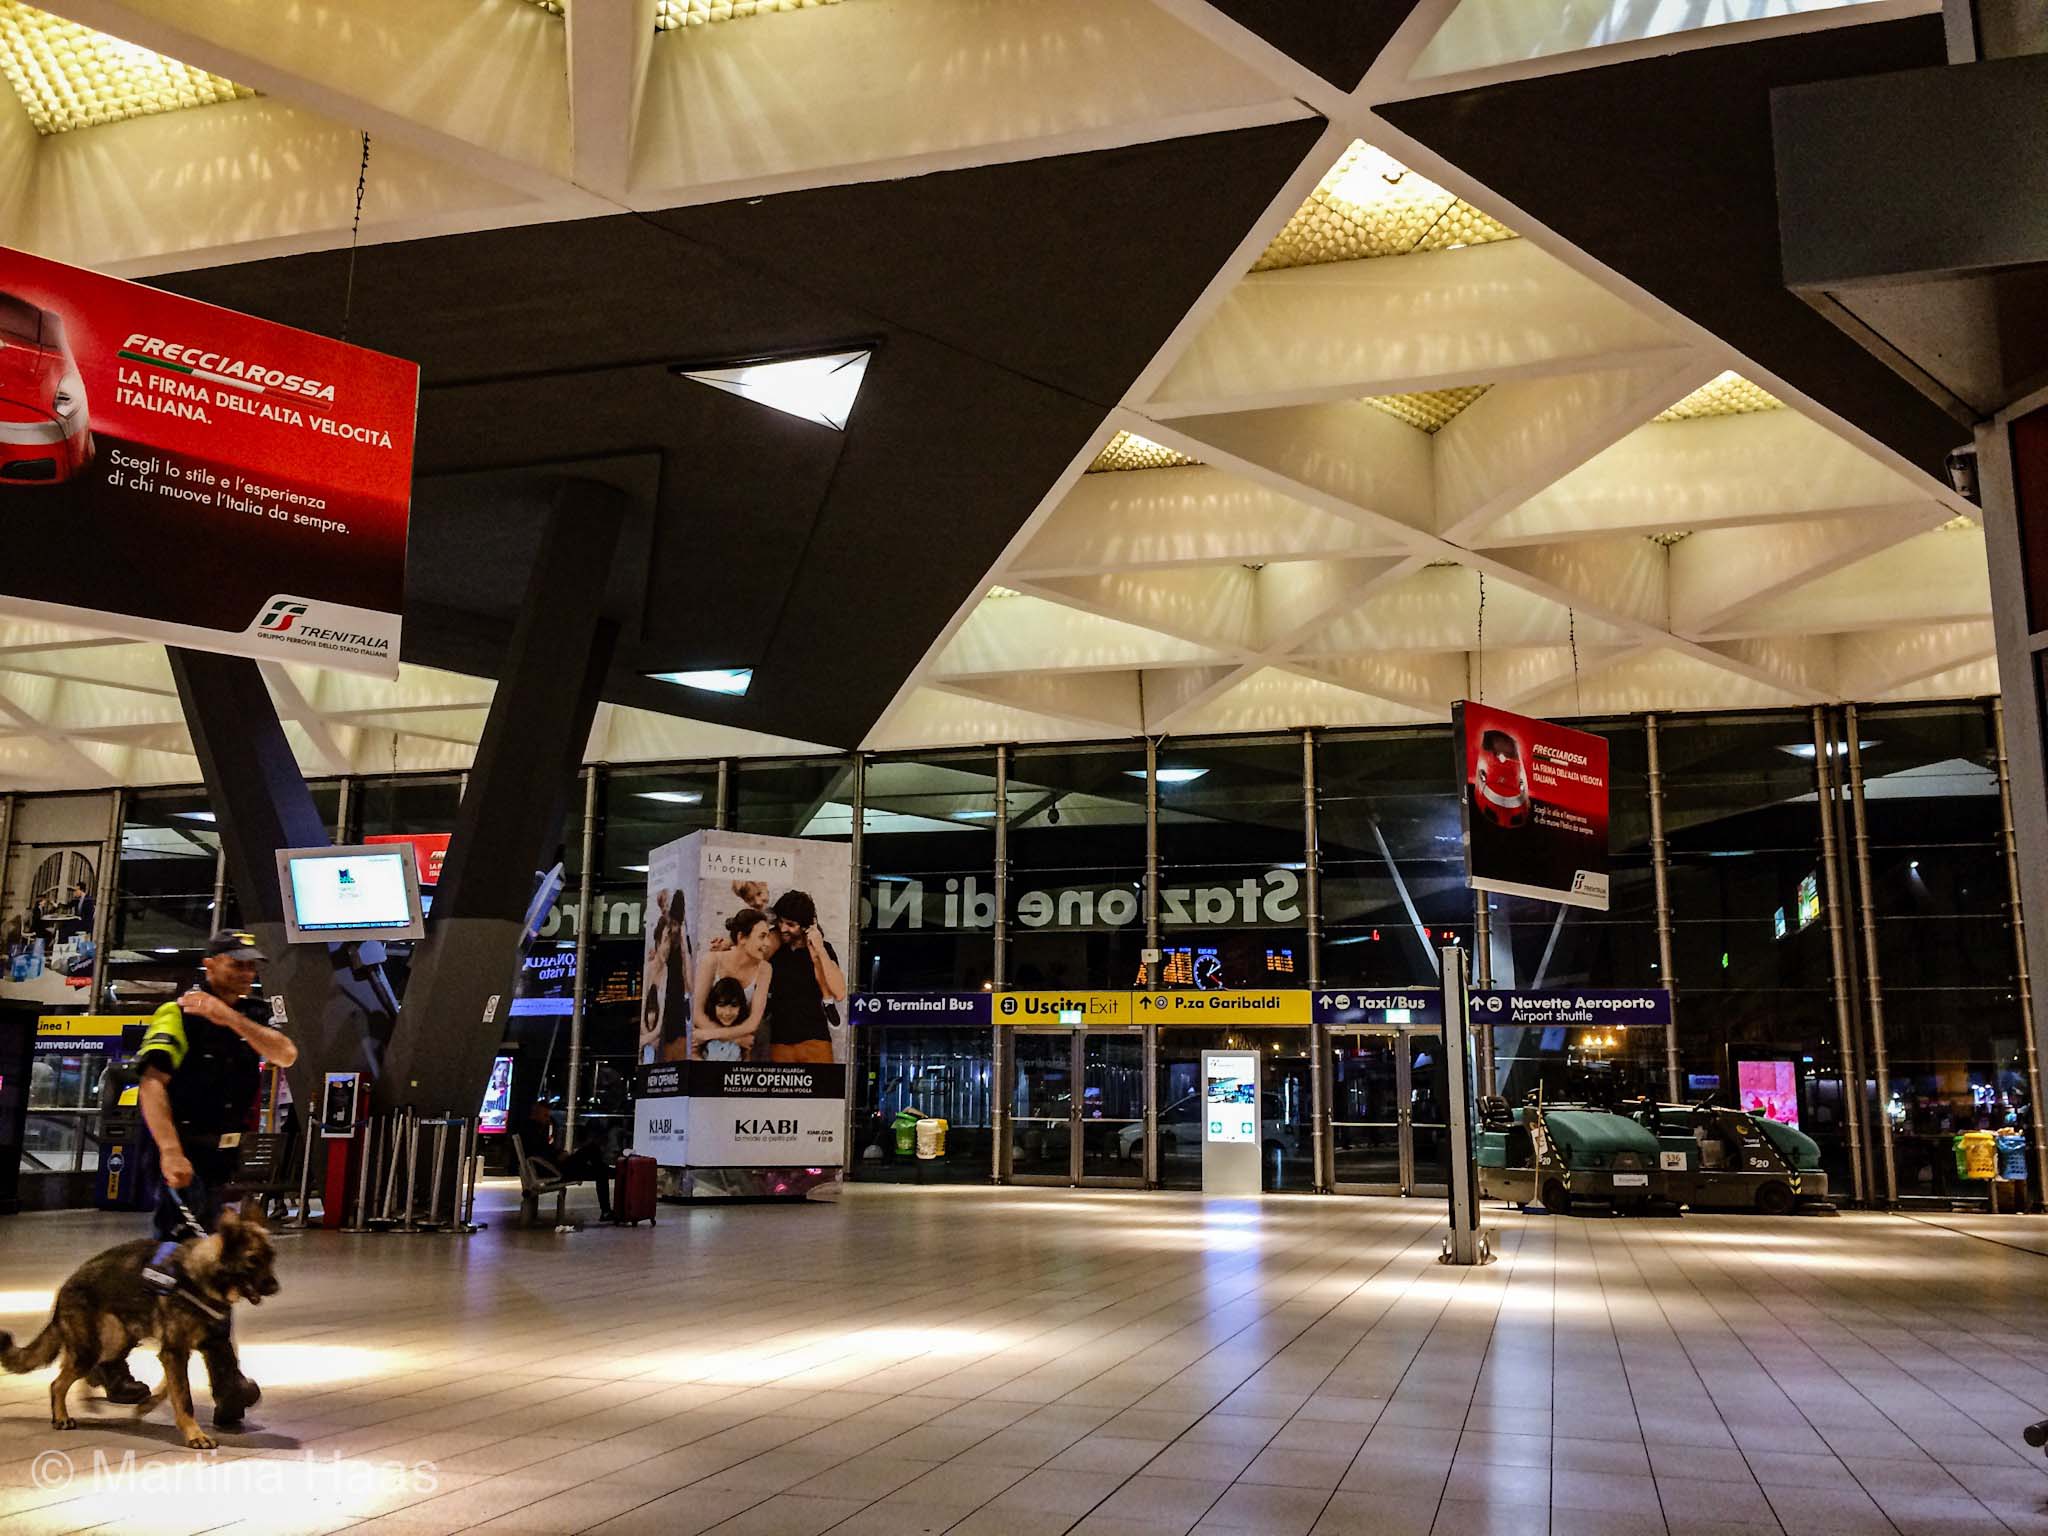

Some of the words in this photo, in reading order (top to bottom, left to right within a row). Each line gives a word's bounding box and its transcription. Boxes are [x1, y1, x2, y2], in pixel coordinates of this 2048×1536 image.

[122, 333, 335, 401] FRECCIAROSSA
[116, 387, 212, 424] ITALIANA.
[119, 366, 142, 387] LA
[149, 374, 210, 404] FIRMA
[215, 391, 304, 428] DELL'ALTA
[308, 414, 393, 449] VELOCITÀ
[110, 449, 160, 475] Scegli
[165, 460, 180, 478] lo
[185, 468, 216, 486] stile
[221, 478, 231, 488] e
[235, 476, 327, 510] l'esperienza
[107, 470, 124, 486] di
[129, 475, 154, 492] chi
[159, 484, 212, 505] muove
[216, 492, 264, 516] l'Italia
[268, 504, 289, 521] da
[293, 513, 350, 534] sempre.
[299, 625, 389, 650] TRENITALIA
[257, 632, 286, 642] GRUPPO
[318, 642, 339, 651] DELLO
[340, 645, 360, 654] STATO
[360, 649, 388, 659] ITALIANE
[1532, 744, 1588, 766] FRECCIAROSSA
[1533, 762, 1540, 772] LA
[708, 854, 723, 863] LA
[731, 855, 788, 868] FELICITÀ
[722, 866, 752, 874] DONA
[887, 998, 946, 1011] Terminal
[949, 998, 974, 1011] Bus
[1024, 997, 1087, 1015] Uscita
[1089, 997, 1119, 1015] Exit
[1175, 996, 1205, 1009] P.za
[1209, 996, 1281, 1009] Garibaldi
[1357, 996, 1426, 1009] Taxi/Bus
[1510, 996, 1571, 1009] Navette
[1575, 996, 1656, 1010] Aeroporto
[1511, 1009, 1553, 1022] Airport
[1555, 1009, 1593, 1022] shuttle
[66, 1020, 71, 1031] 1
[724, 1073, 754, 1086] NEW
[757, 1073, 813, 1087] OPENING
[649, 1119, 672, 1134] KIABI
[735, 1119, 799, 1135] KIABI
[1749, 1156, 1770, 1168] S20
